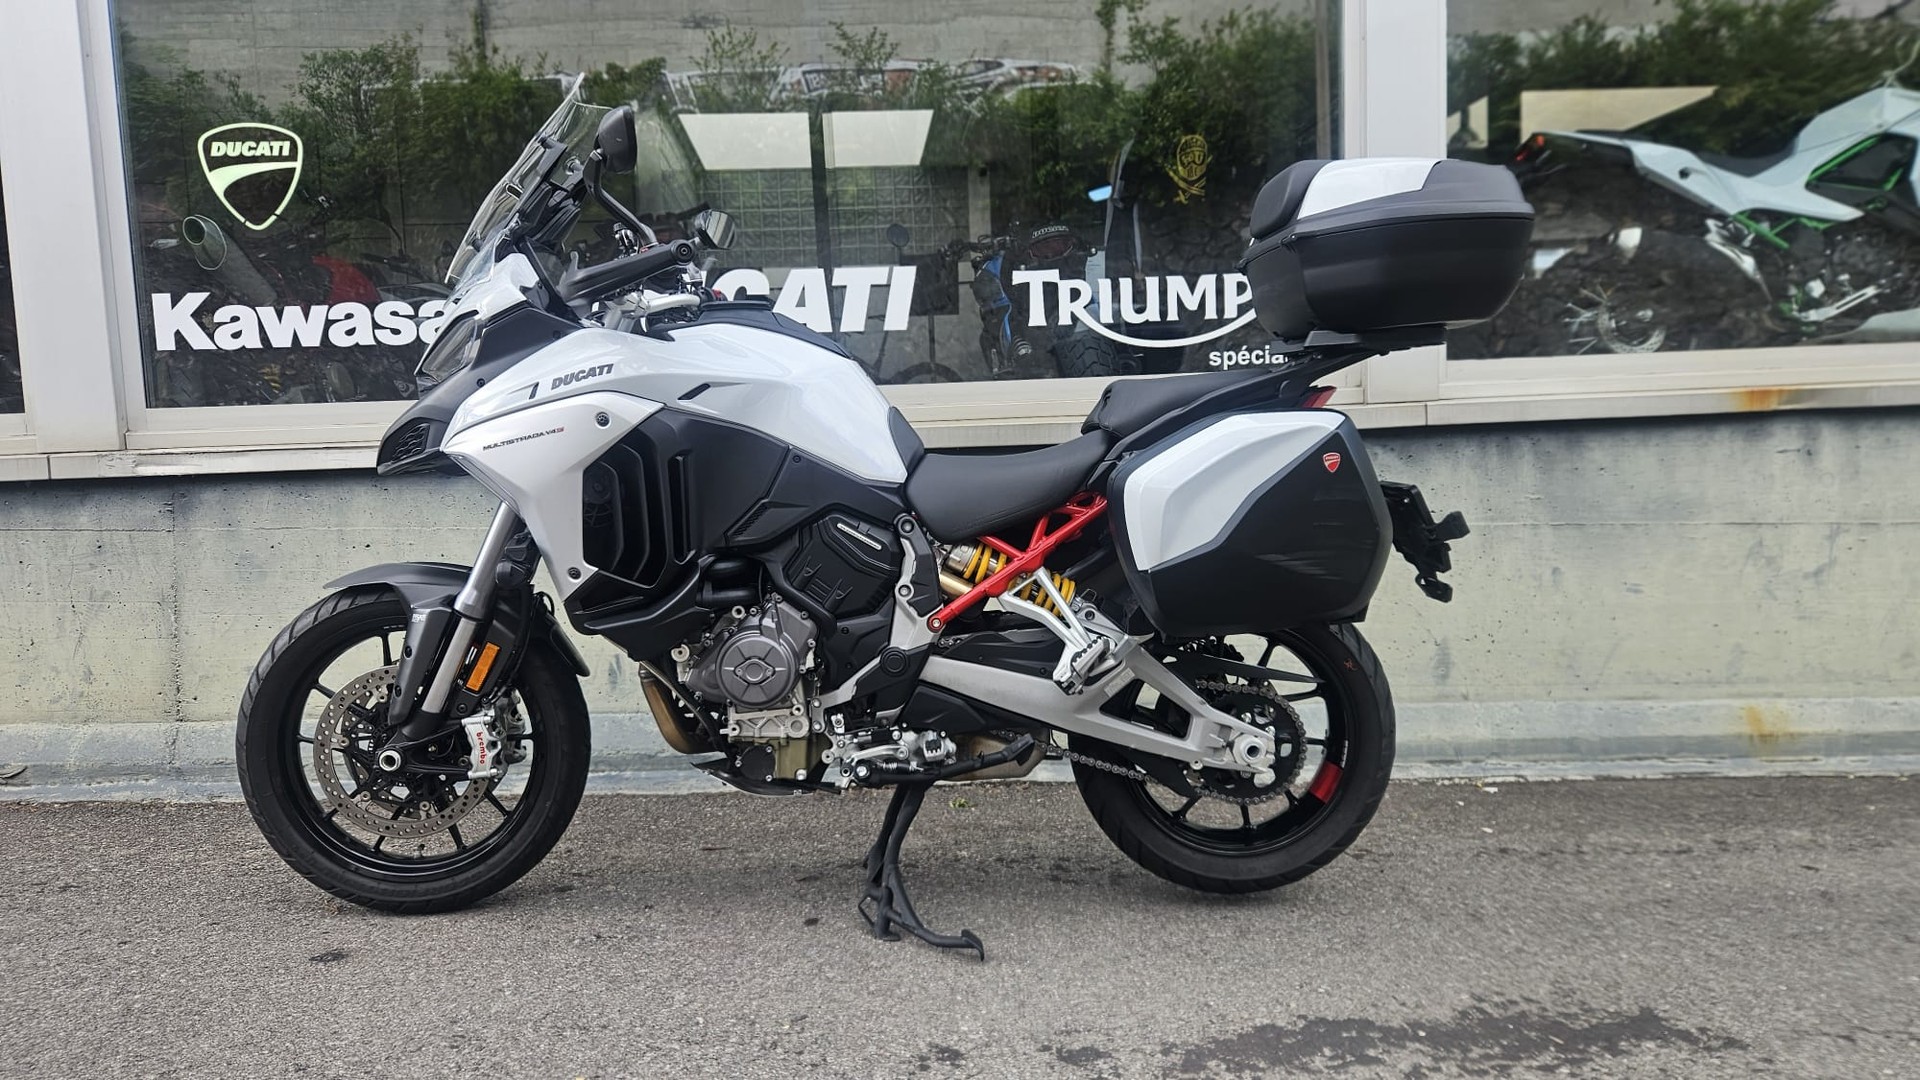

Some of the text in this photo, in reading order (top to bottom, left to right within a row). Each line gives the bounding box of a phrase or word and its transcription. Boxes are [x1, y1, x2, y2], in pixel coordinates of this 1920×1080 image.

[210, 141, 291, 157] DUCATI
[700, 265, 917, 333] CATI
[1208, 344, 1289, 371] spécia
[551, 363, 614, 390] DUCATI
[476, 731, 487, 764] brembo
